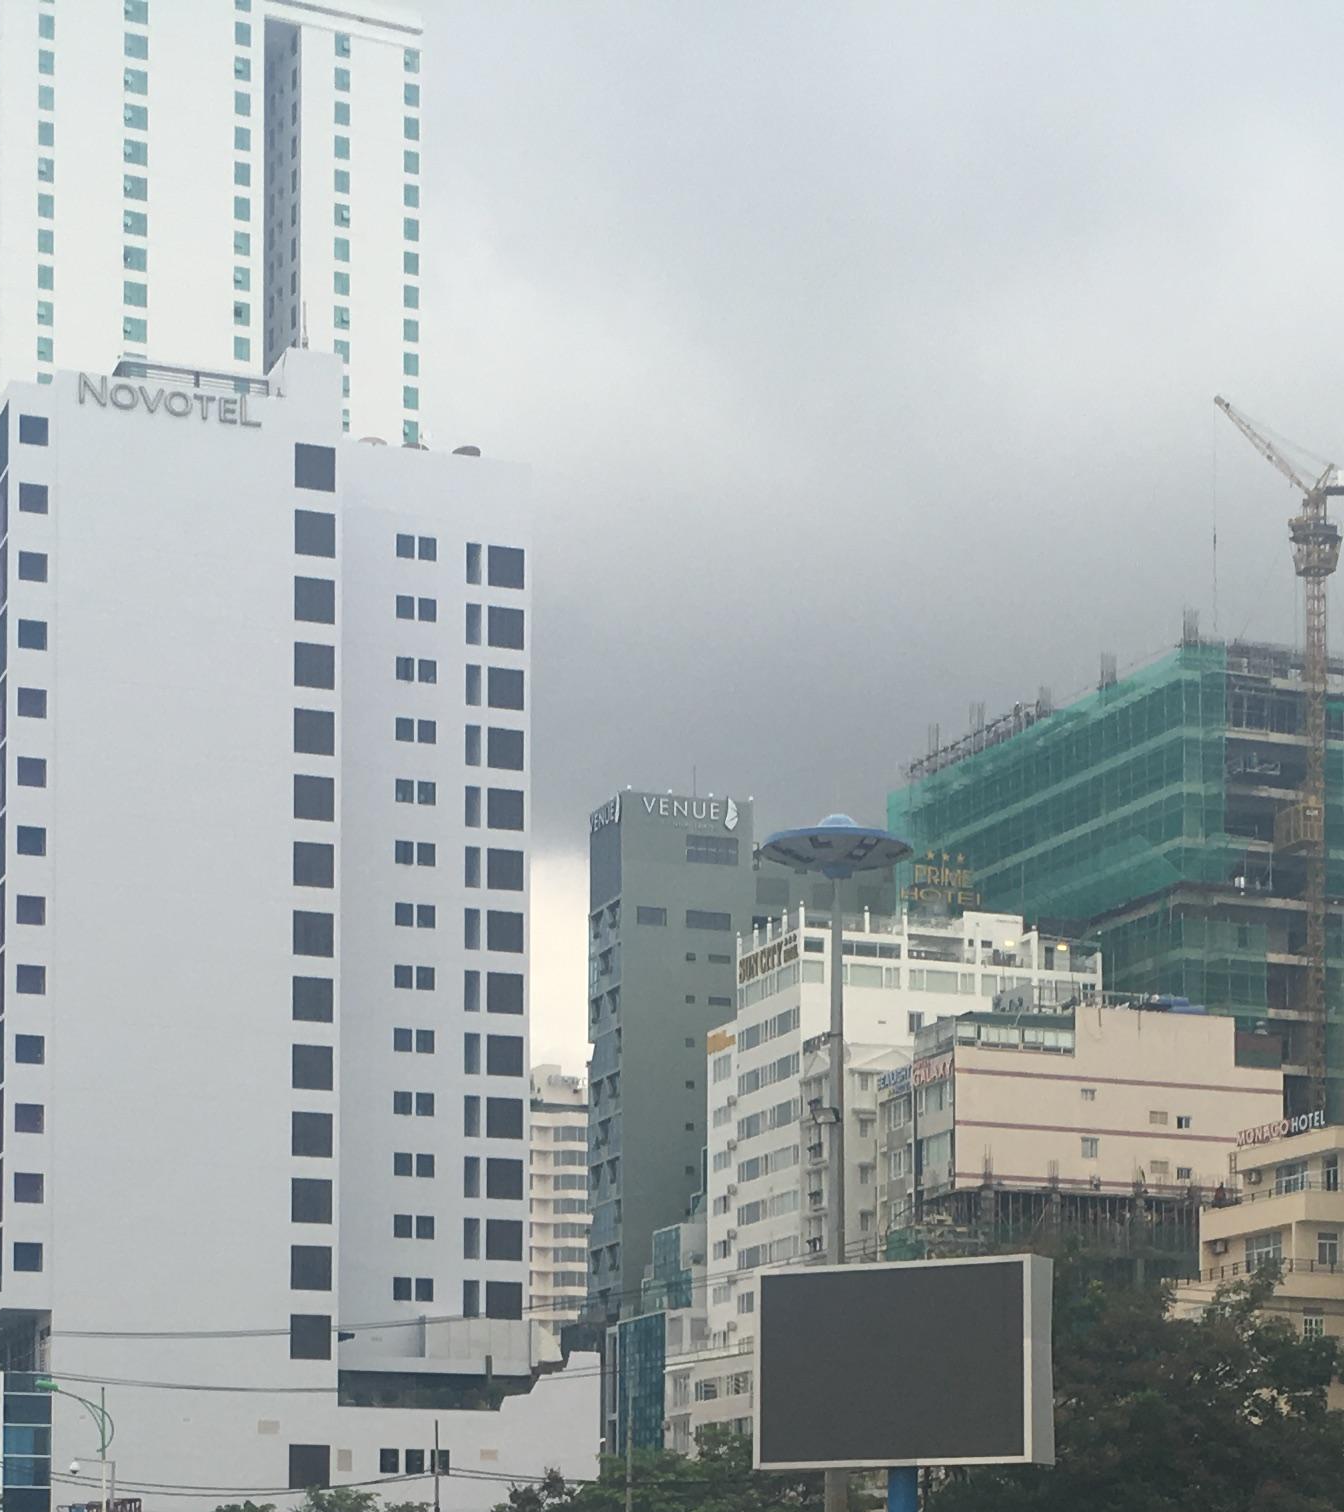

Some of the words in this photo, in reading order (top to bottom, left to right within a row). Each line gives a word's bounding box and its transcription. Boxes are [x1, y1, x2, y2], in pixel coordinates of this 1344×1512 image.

[77, 371, 262, 428] NOVOTEL
[643, 796, 720, 820] VENUE
[914, 864, 974, 889] PRIME
[913, 1057, 954, 1087] GALAXY
[1236, 1120, 1289, 1146] MONACO
[1291, 1110, 1326, 1134] HOTEL
